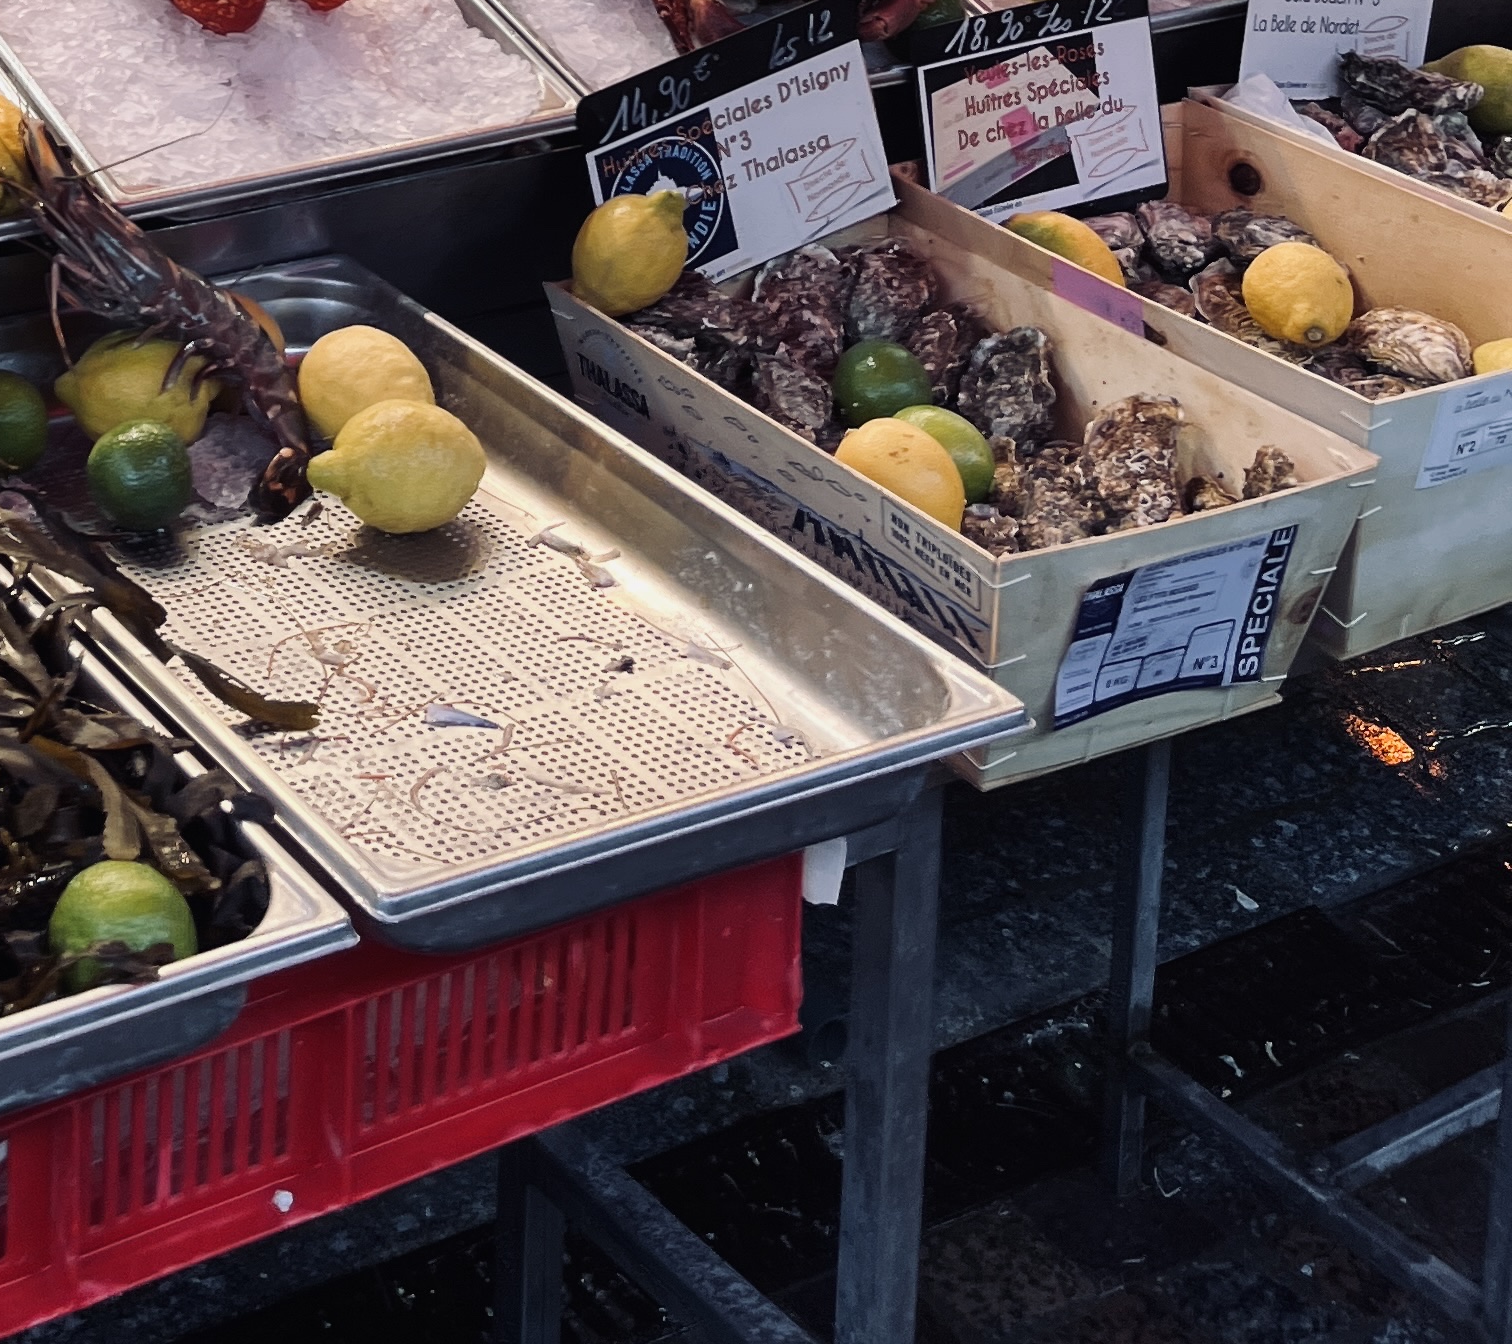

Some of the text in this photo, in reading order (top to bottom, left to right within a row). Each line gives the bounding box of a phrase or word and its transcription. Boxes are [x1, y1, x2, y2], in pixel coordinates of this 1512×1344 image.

[1253, 14, 1267, 32] La
[1271, 14, 1296, 33] Belle
[1300, 15, 1315, 34] de
[1027, 69, 1110, 104] Spéciales
[958, 102, 1096, 151] De Belle
[741, 132, 831, 183] Thalassa
[1237, 526, 1294, 678] SPECIALE
